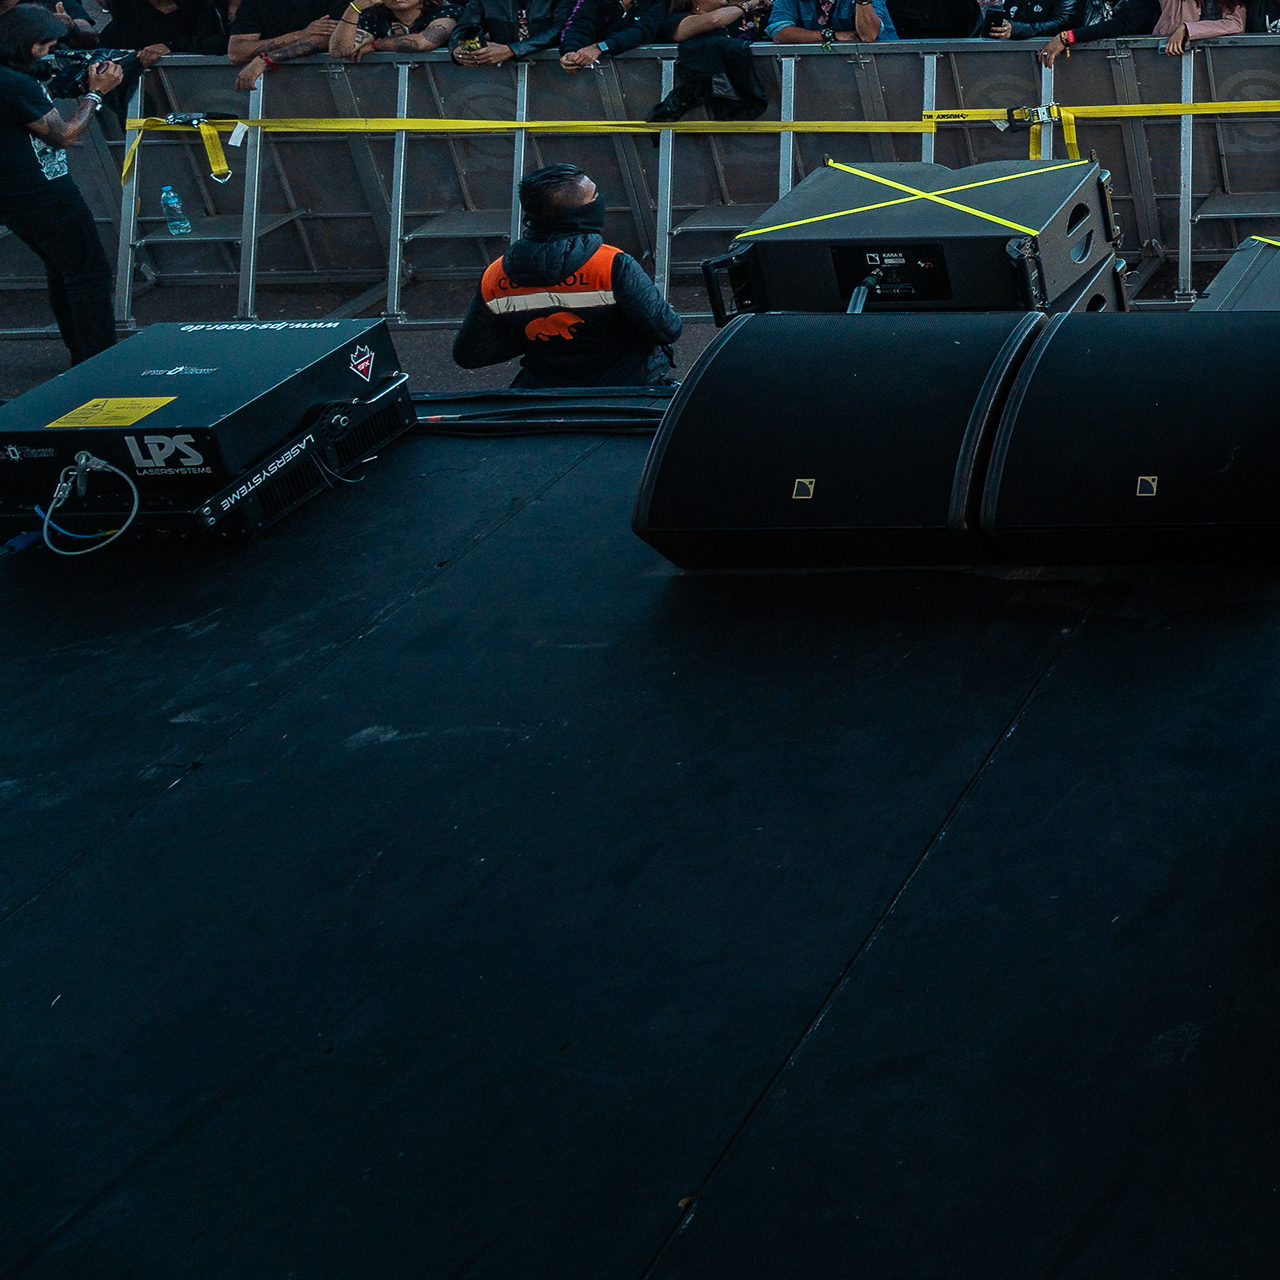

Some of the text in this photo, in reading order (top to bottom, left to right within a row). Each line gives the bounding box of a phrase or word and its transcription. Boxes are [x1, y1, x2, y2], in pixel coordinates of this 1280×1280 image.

[180, 321, 340, 333] www.lps-laser.de
[124, 434, 204, 468] LPS
[135, 466, 213, 476] LASERSYSTEME
[221, 434, 316, 512] LASERSYSTEME
